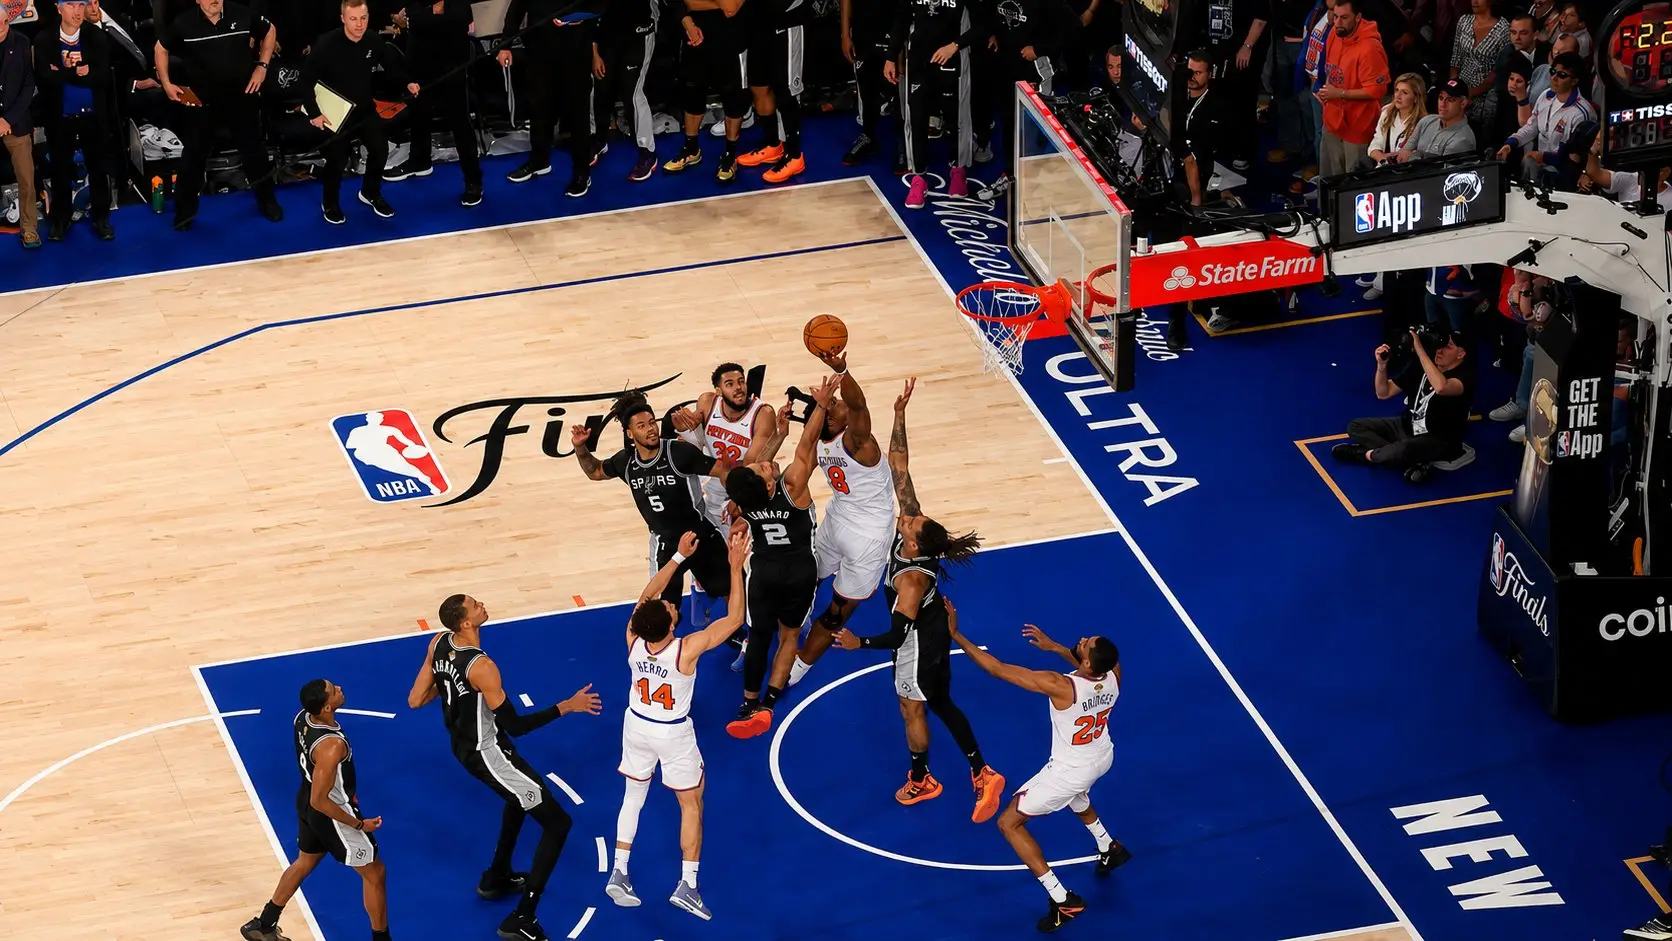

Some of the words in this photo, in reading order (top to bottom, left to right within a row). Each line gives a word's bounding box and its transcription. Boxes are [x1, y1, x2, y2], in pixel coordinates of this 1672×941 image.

[1377, 191, 1421, 233] App
[1198, 260, 1258, 287] State
[1259, 256, 1316, 279] Farm
[1569, 377, 1601, 404] GET
[1045, 351, 1200, 507] ULTRA
[1567, 403, 1599, 429] THE
[1570, 430, 1603, 460] App
[376, 478, 421, 498] NBA
[631, 475, 676, 494] SPURS
[827, 465, 851, 495] 8
[647, 495, 665, 513] 5
[761, 523, 791, 545] 2
[1496, 551, 1550, 637] Finals
[1599, 596, 1672, 641] coi
[636, 661, 668, 679] HERRO
[637, 677, 675, 710] 14
[1071, 707, 1112, 745] 25
[1389, 794, 1566, 910] NEW
